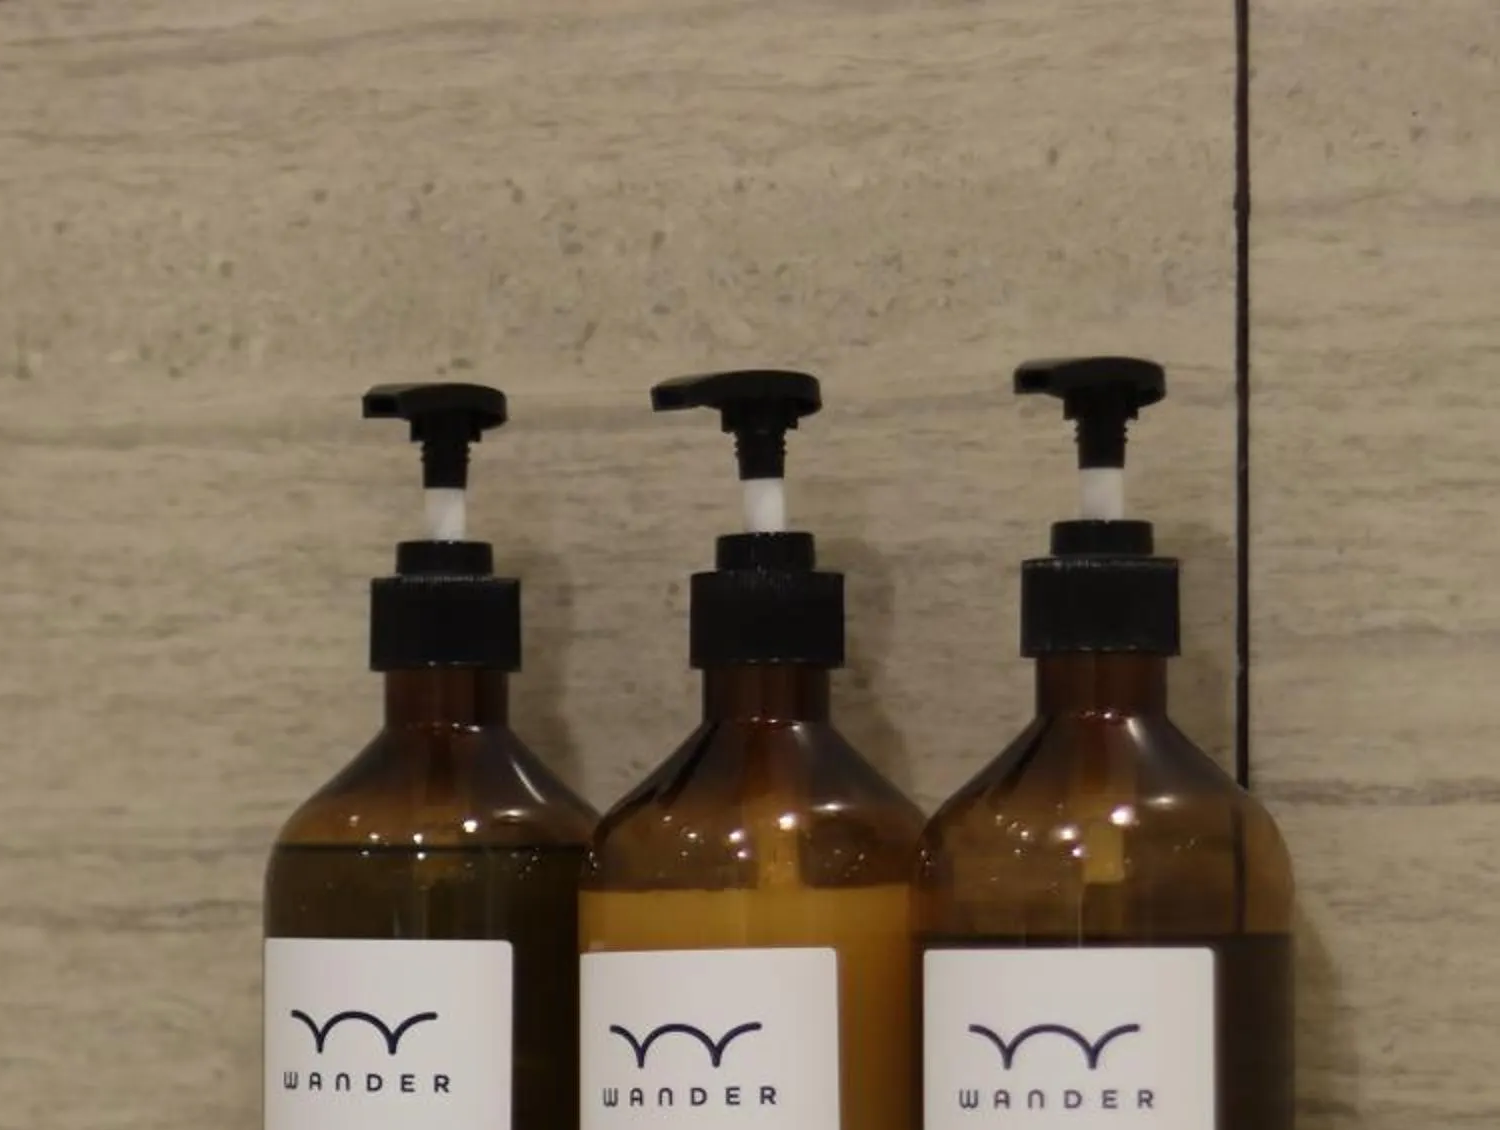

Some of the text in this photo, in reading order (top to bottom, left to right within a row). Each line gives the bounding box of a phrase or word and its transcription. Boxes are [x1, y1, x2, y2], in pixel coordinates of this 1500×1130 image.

[283, 1071, 451, 1094] WANDER
[603, 1086, 777, 1108] WANDER
[958, 1088, 1155, 1110] WANDER
